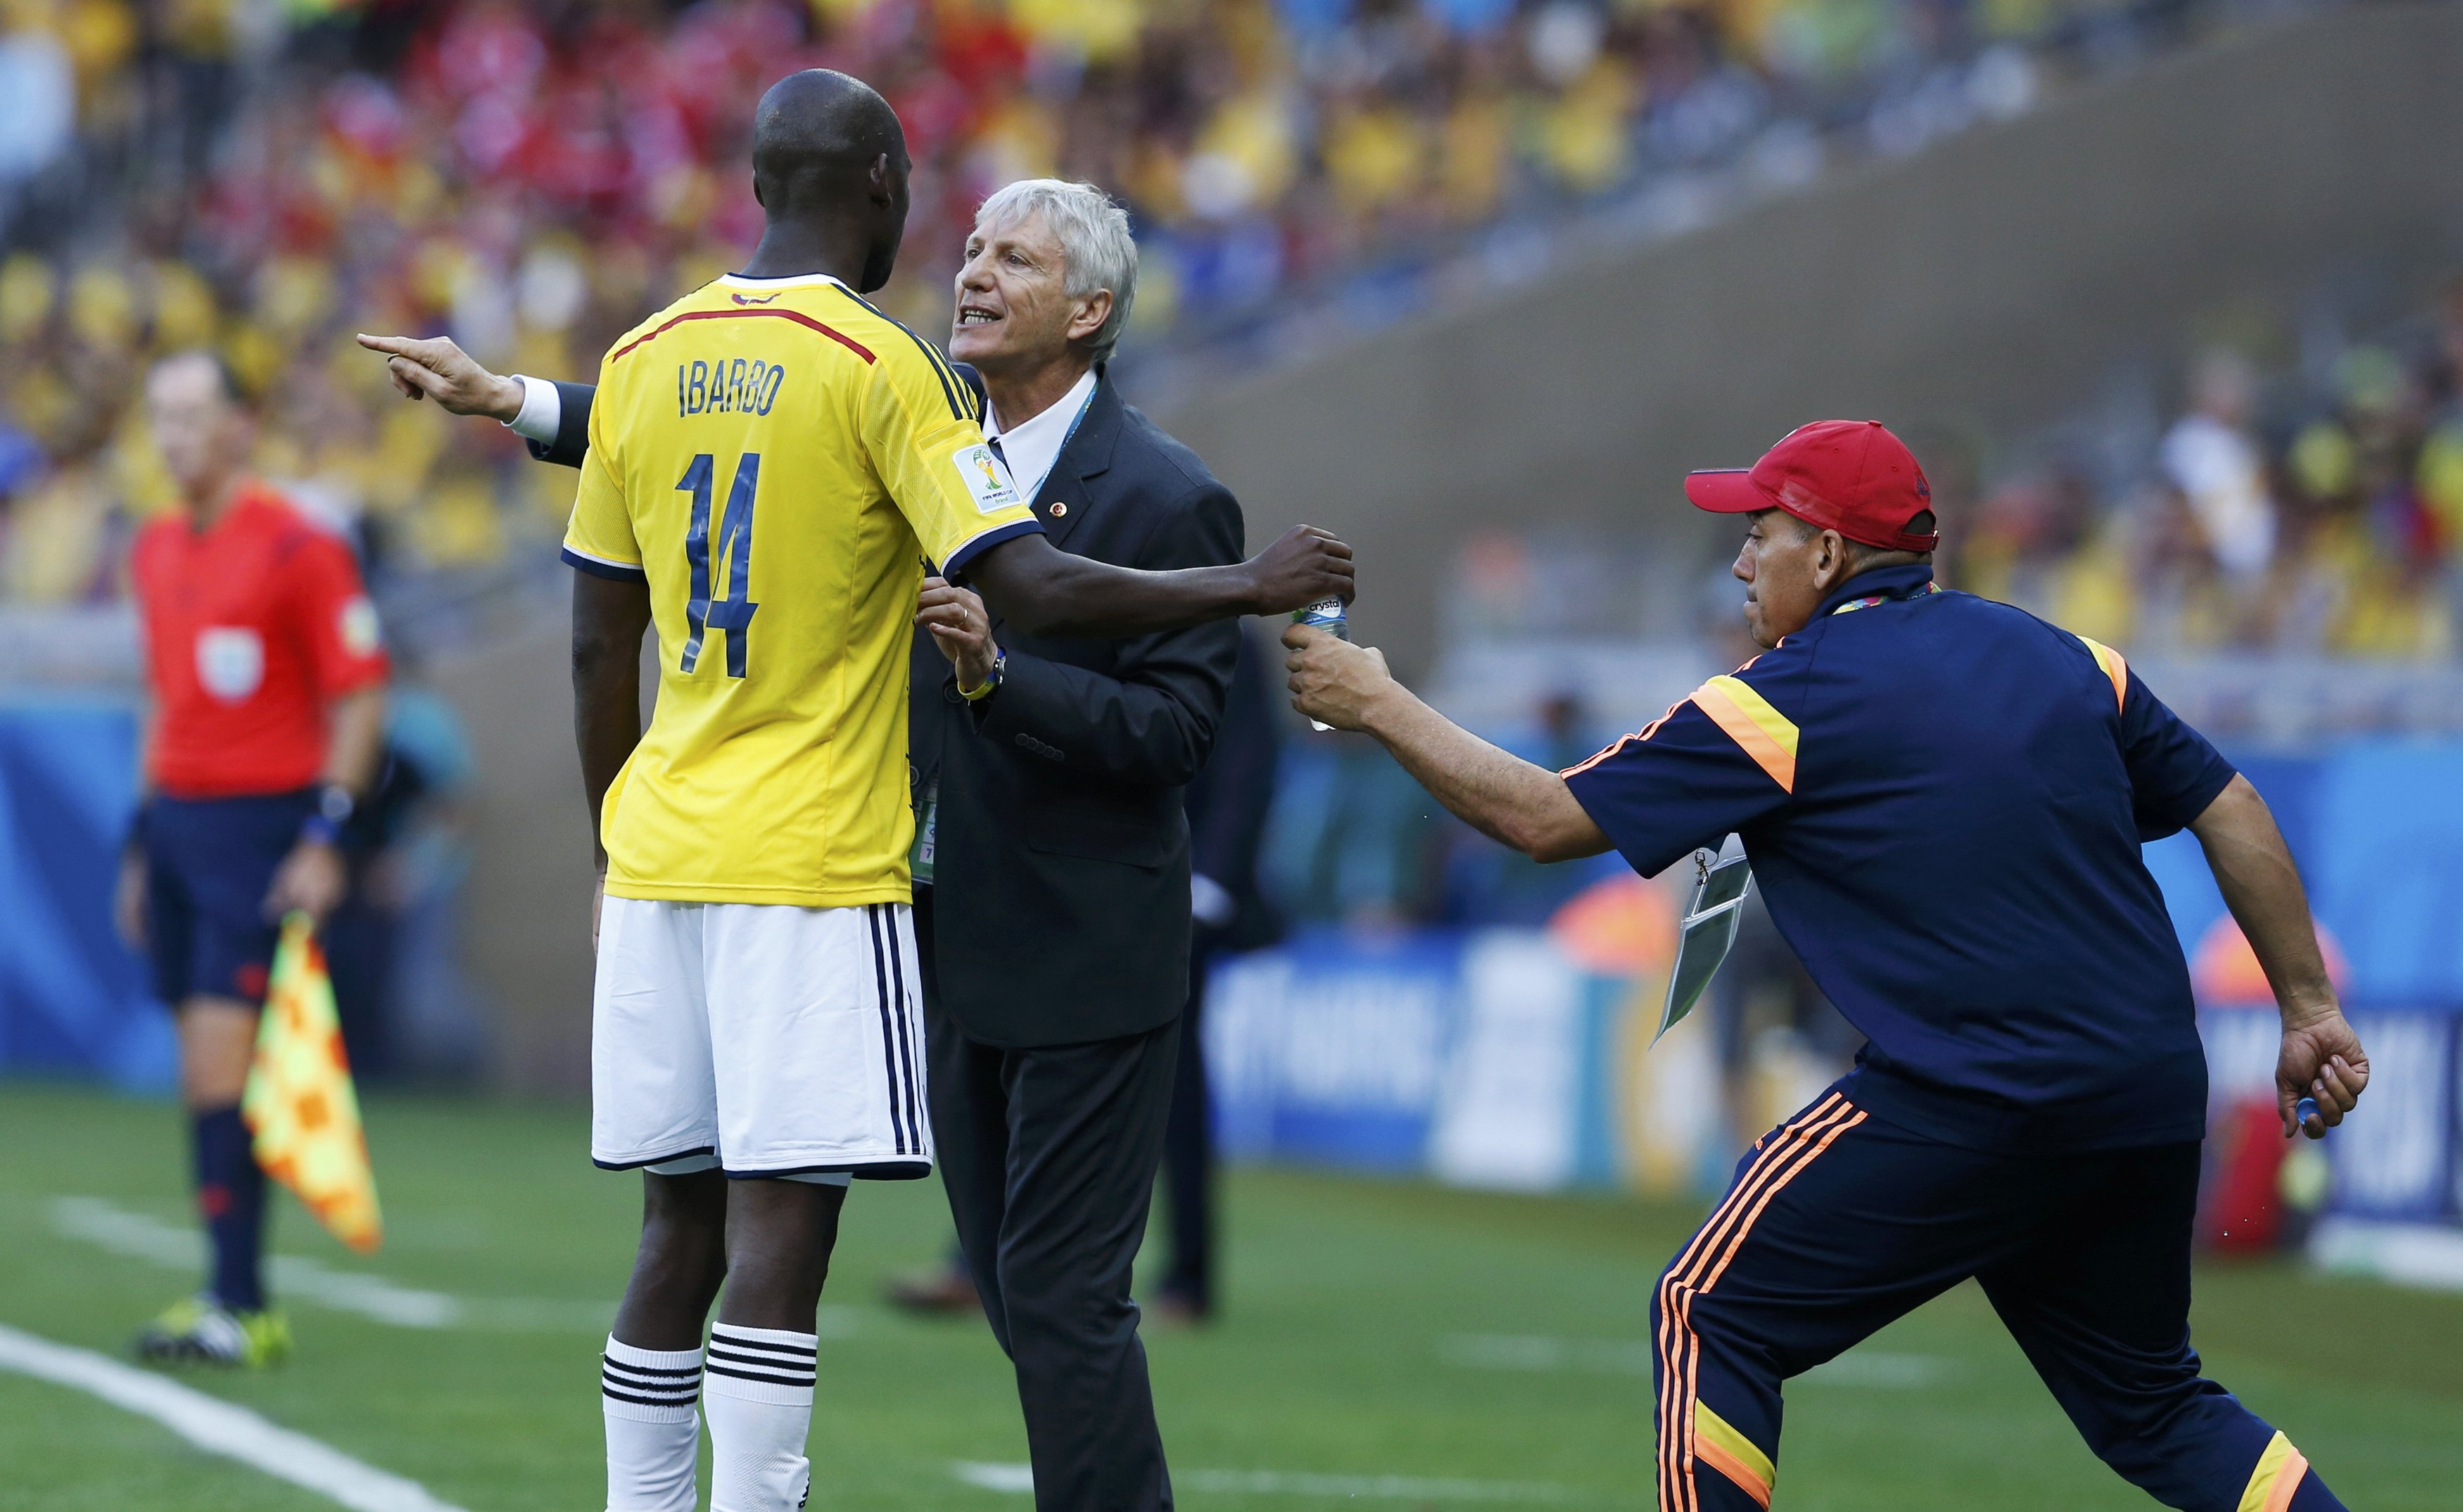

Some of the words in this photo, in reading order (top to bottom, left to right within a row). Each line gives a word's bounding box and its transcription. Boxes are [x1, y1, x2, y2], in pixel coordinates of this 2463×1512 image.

[678, 358, 785, 418] IBARBO
[674, 452, 760, 679] 14
[1309, 599, 1340, 611] crystal
[926, 848, 932, 858] 7
